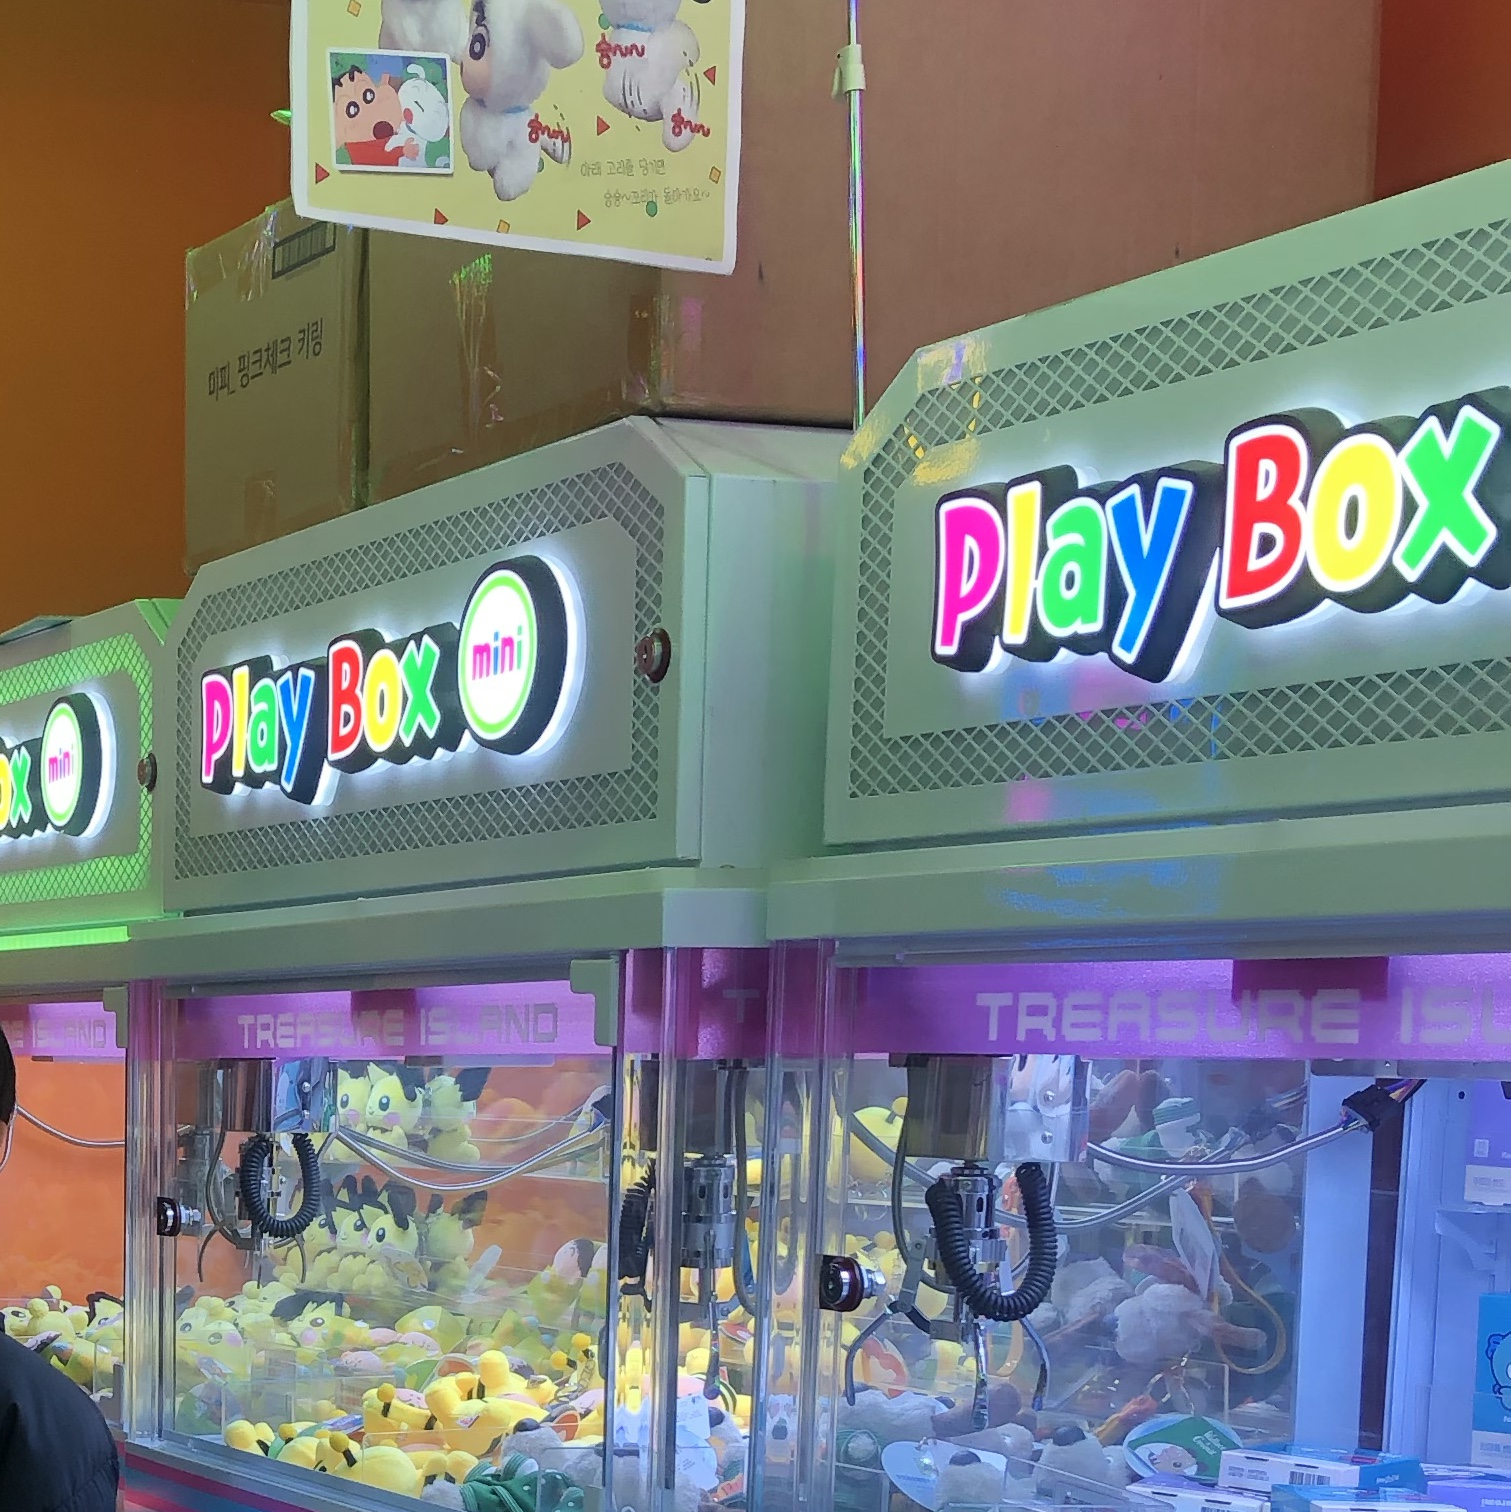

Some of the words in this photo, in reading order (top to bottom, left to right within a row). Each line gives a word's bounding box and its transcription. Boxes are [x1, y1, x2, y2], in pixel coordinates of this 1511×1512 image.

[581, 161, 602, 177] 아래
[238, 336, 292, 388] 핑크체크
[297, 318, 323, 359] 키링
[934, 476, 1194, 665] Play
[1219, 404, 1502, 611] Box
[471, 625, 524, 680] mini
[201, 665, 315, 793] Play
[327, 634, 441, 761] Box
[48, 743, 75, 783] mini
[238, 1008, 404, 1050] TREASURE
[420, 1003, 558, 1046] ISLAND
[976, 988, 1360, 1045] TREASURE
